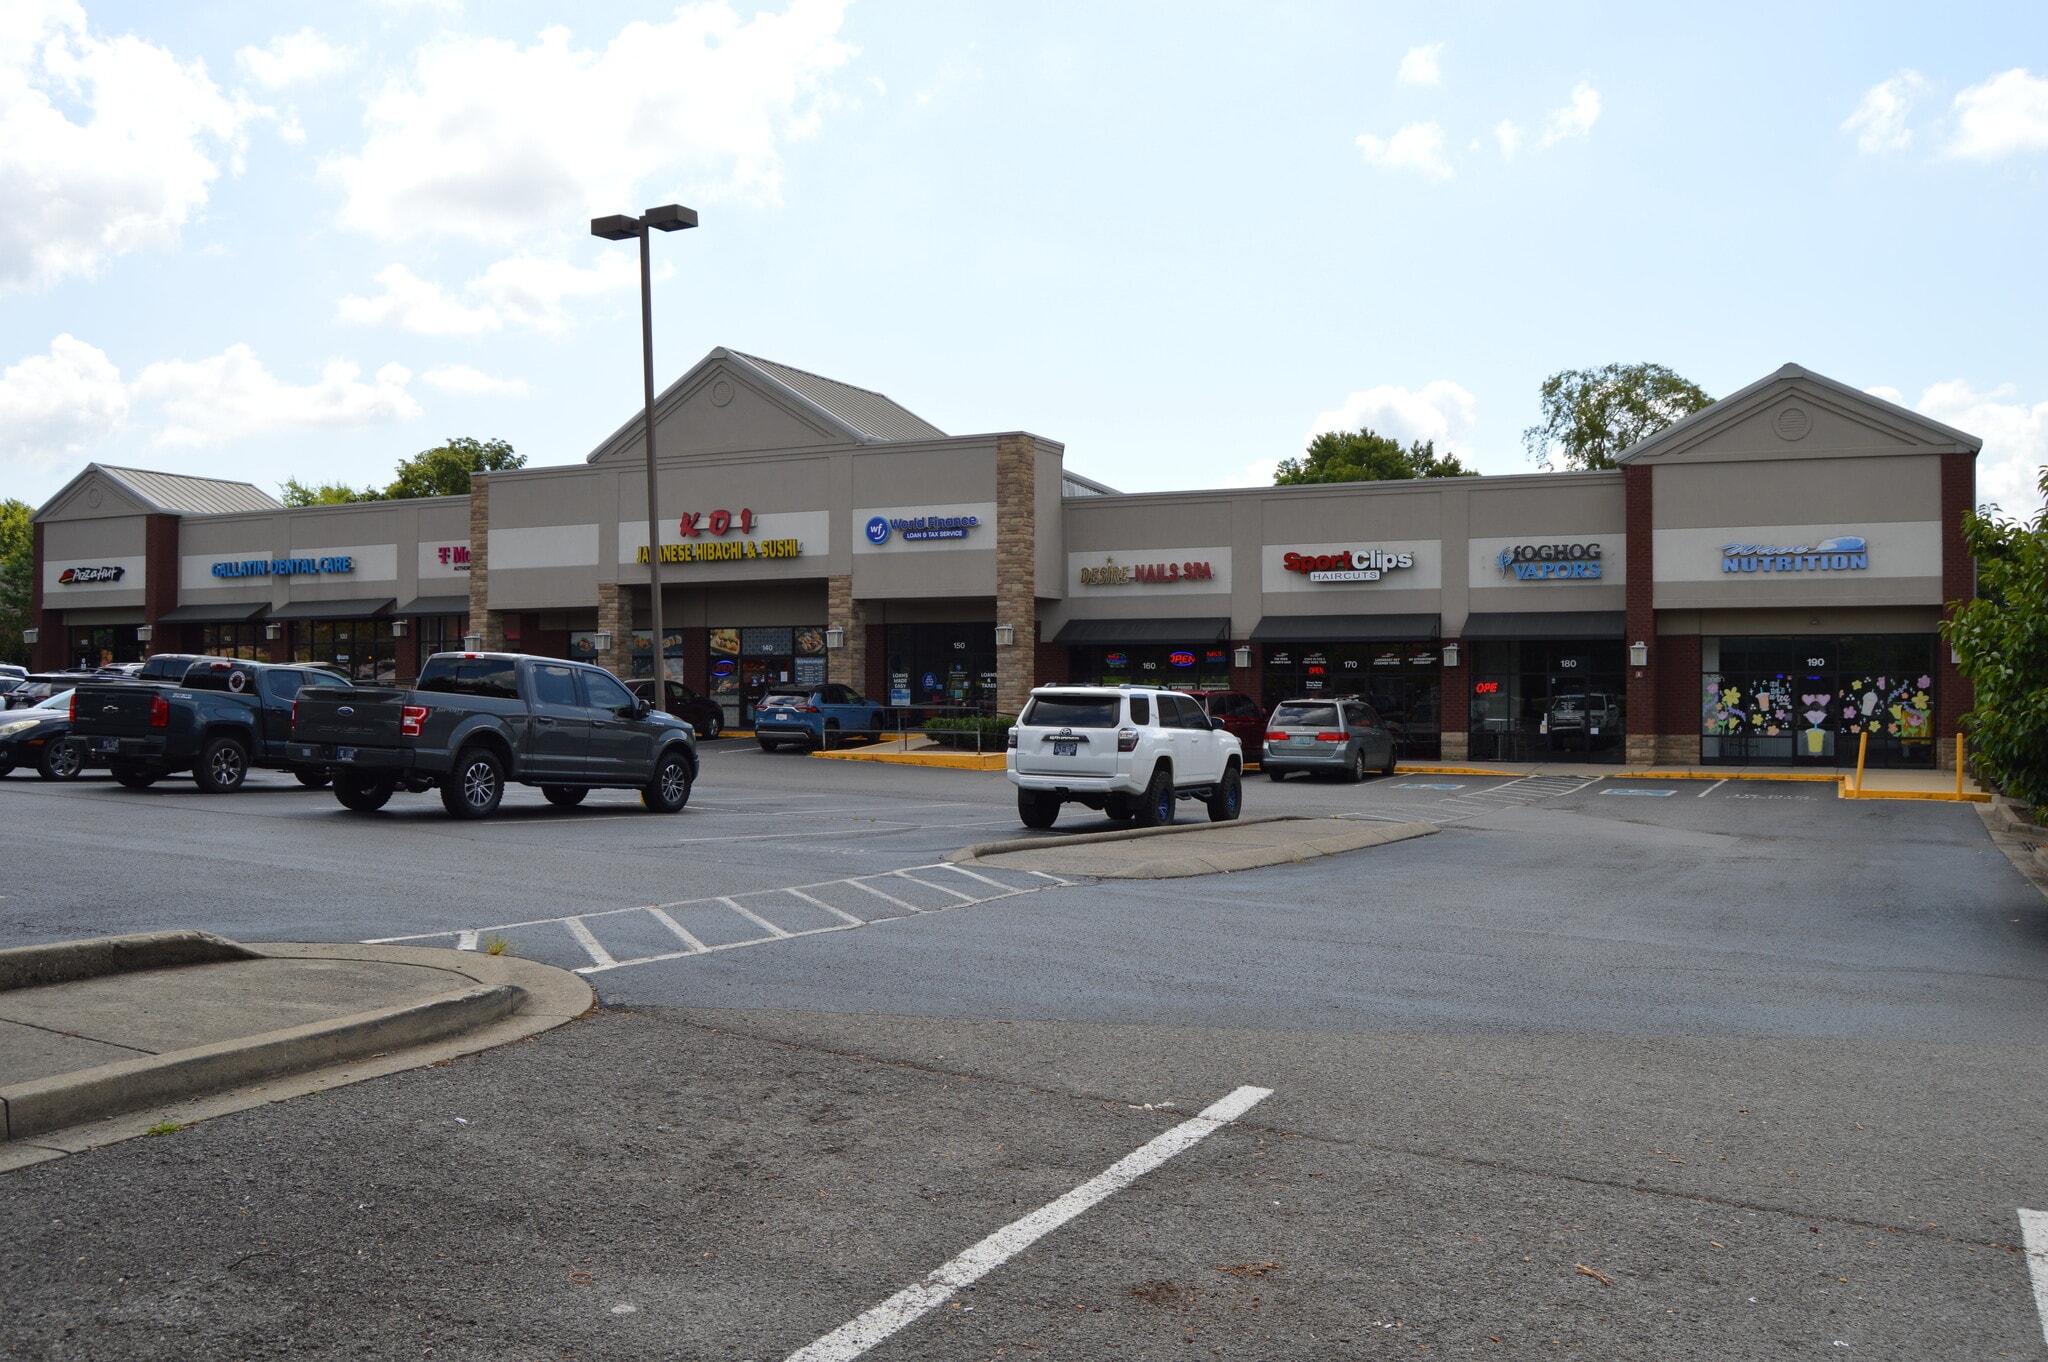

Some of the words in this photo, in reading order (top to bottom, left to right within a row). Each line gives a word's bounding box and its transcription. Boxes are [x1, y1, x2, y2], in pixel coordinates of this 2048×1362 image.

[680, 508, 753, 537] KOI
[890, 517, 925, 530] World
[928, 516, 977, 529] Finance
[695, 541, 743, 561] HIBACHI
[747, 541, 757, 559] &
[761, 539, 798, 557] SUSHI
[1722, 542, 1809, 556] Wave
[212, 560, 266, 579] GALLATIN
[270, 558, 316, 576] DENTAL
[319, 556, 350, 573] CARE
[1513, 561, 1601, 579] VAPORS
[1722, 554, 1868, 572] NUTRITION
[1135, 563, 1179, 582] NAILS
[1183, 562, 1213, 581] SPA
[1313, 572, 1377, 581] HAIRCUTS
[762, 644, 773, 652] 140
[1142, 662, 1156, 670] 160
[1344, 661, 1358, 669] 170
[1560, 659, 1577, 668] 180
[1806, 658, 1825, 667] 190
[1308, 666, 1325, 675] OPEN
